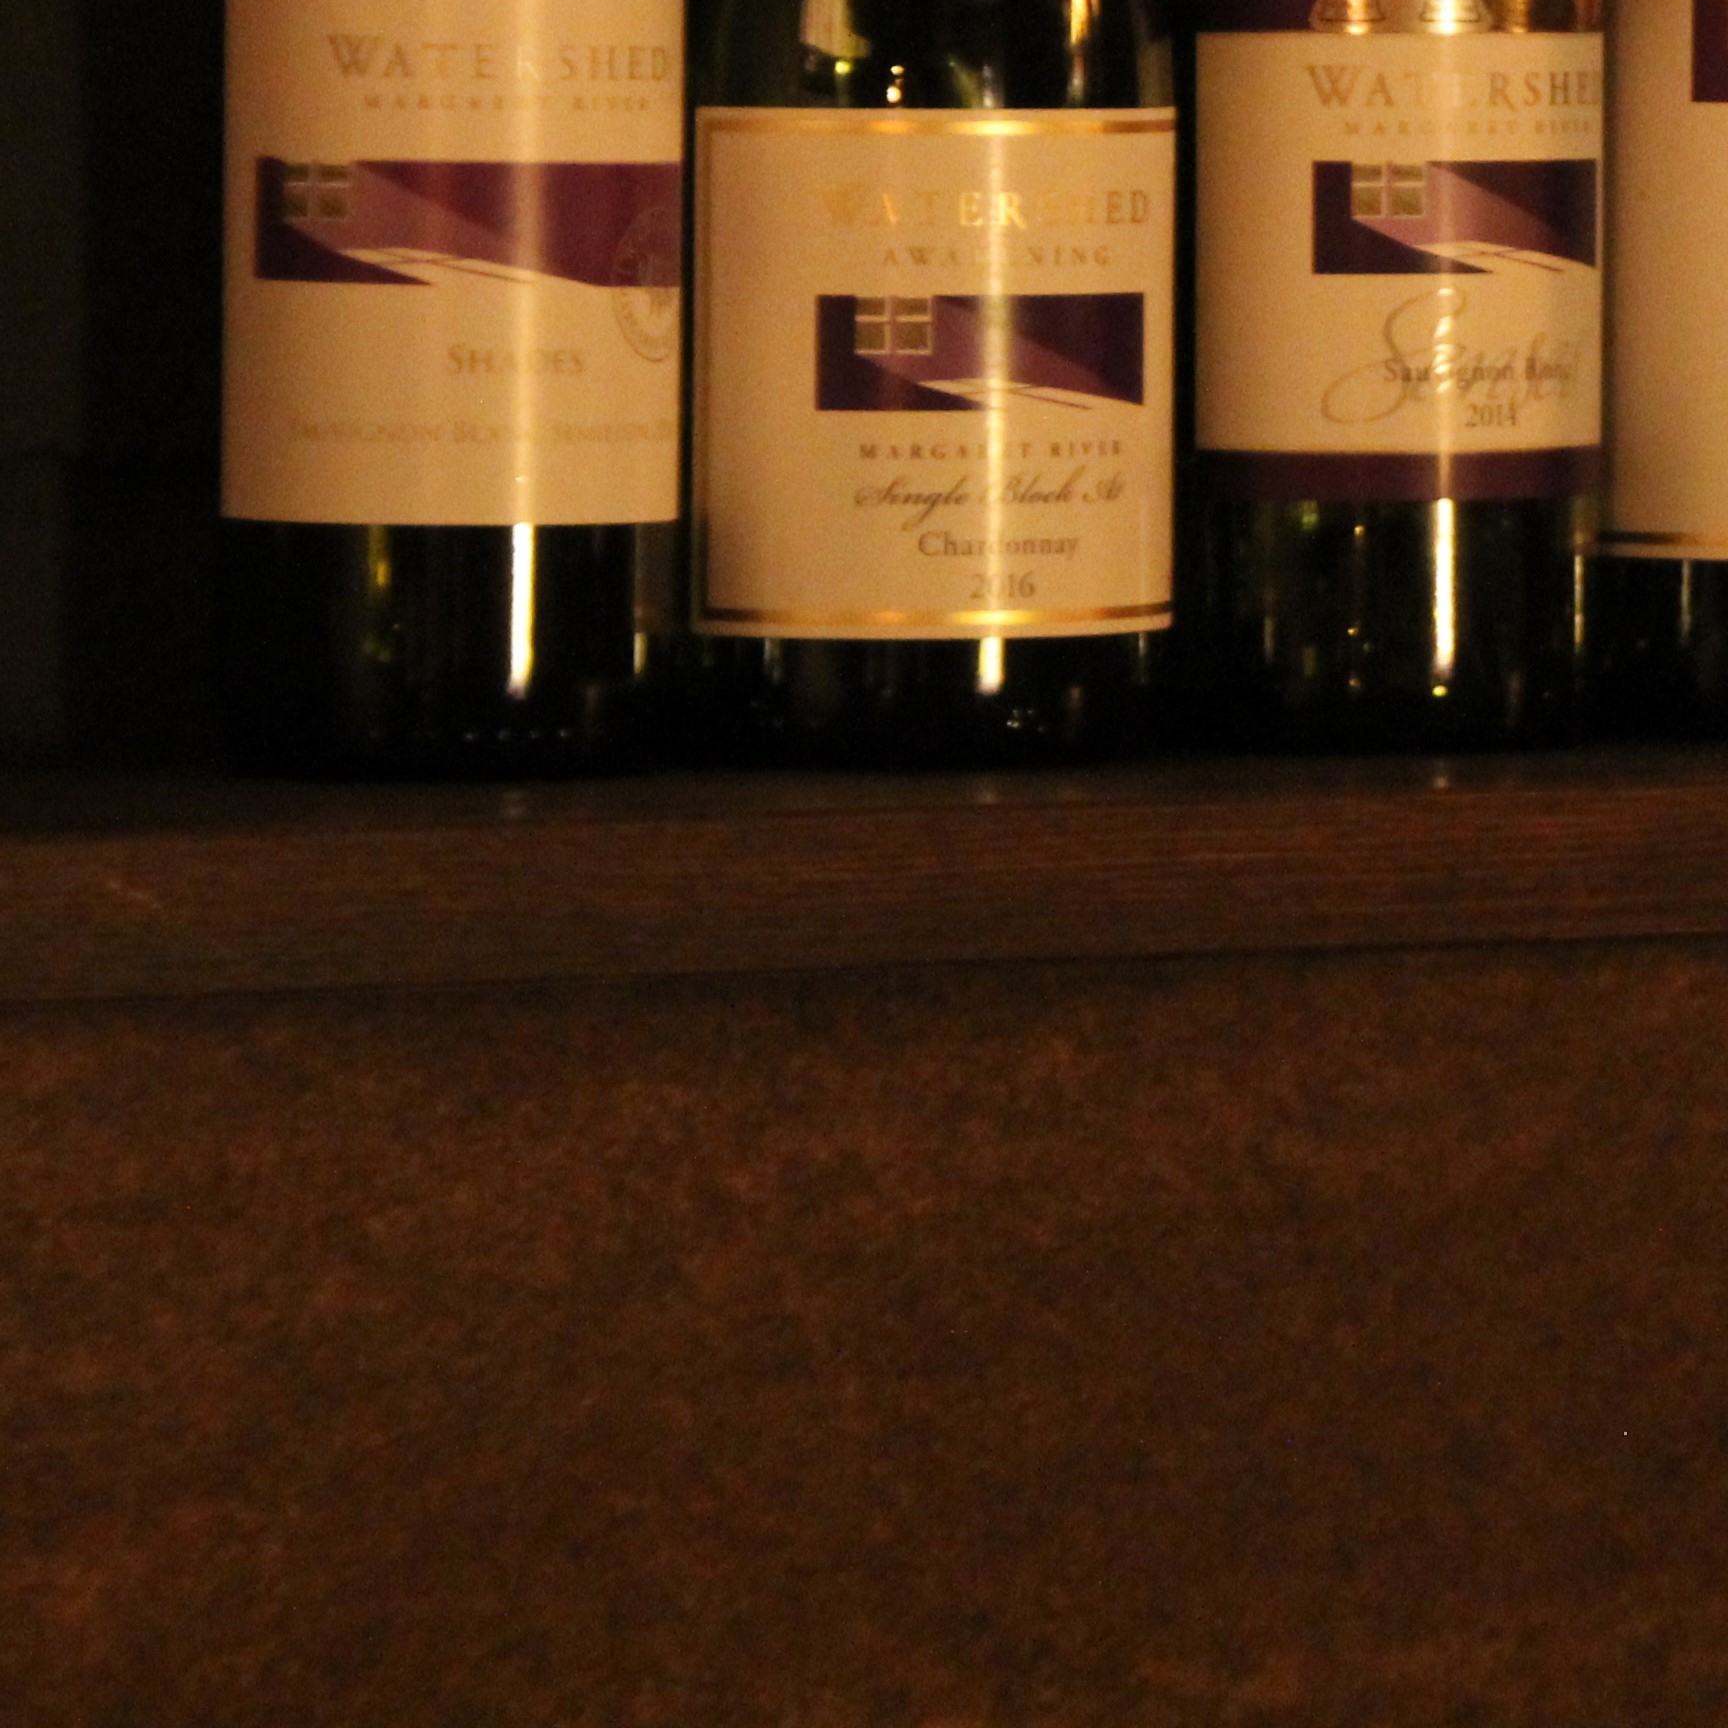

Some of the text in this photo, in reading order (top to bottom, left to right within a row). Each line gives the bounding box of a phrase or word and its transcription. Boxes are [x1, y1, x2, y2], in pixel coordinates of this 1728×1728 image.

[327, 33, 672, 83] WATERSHED
[1465, 402, 1518, 428] 2014
[858, 439, 1124, 460] MARGAT RIVER
[917, 530, 1080, 561] Charonnay
